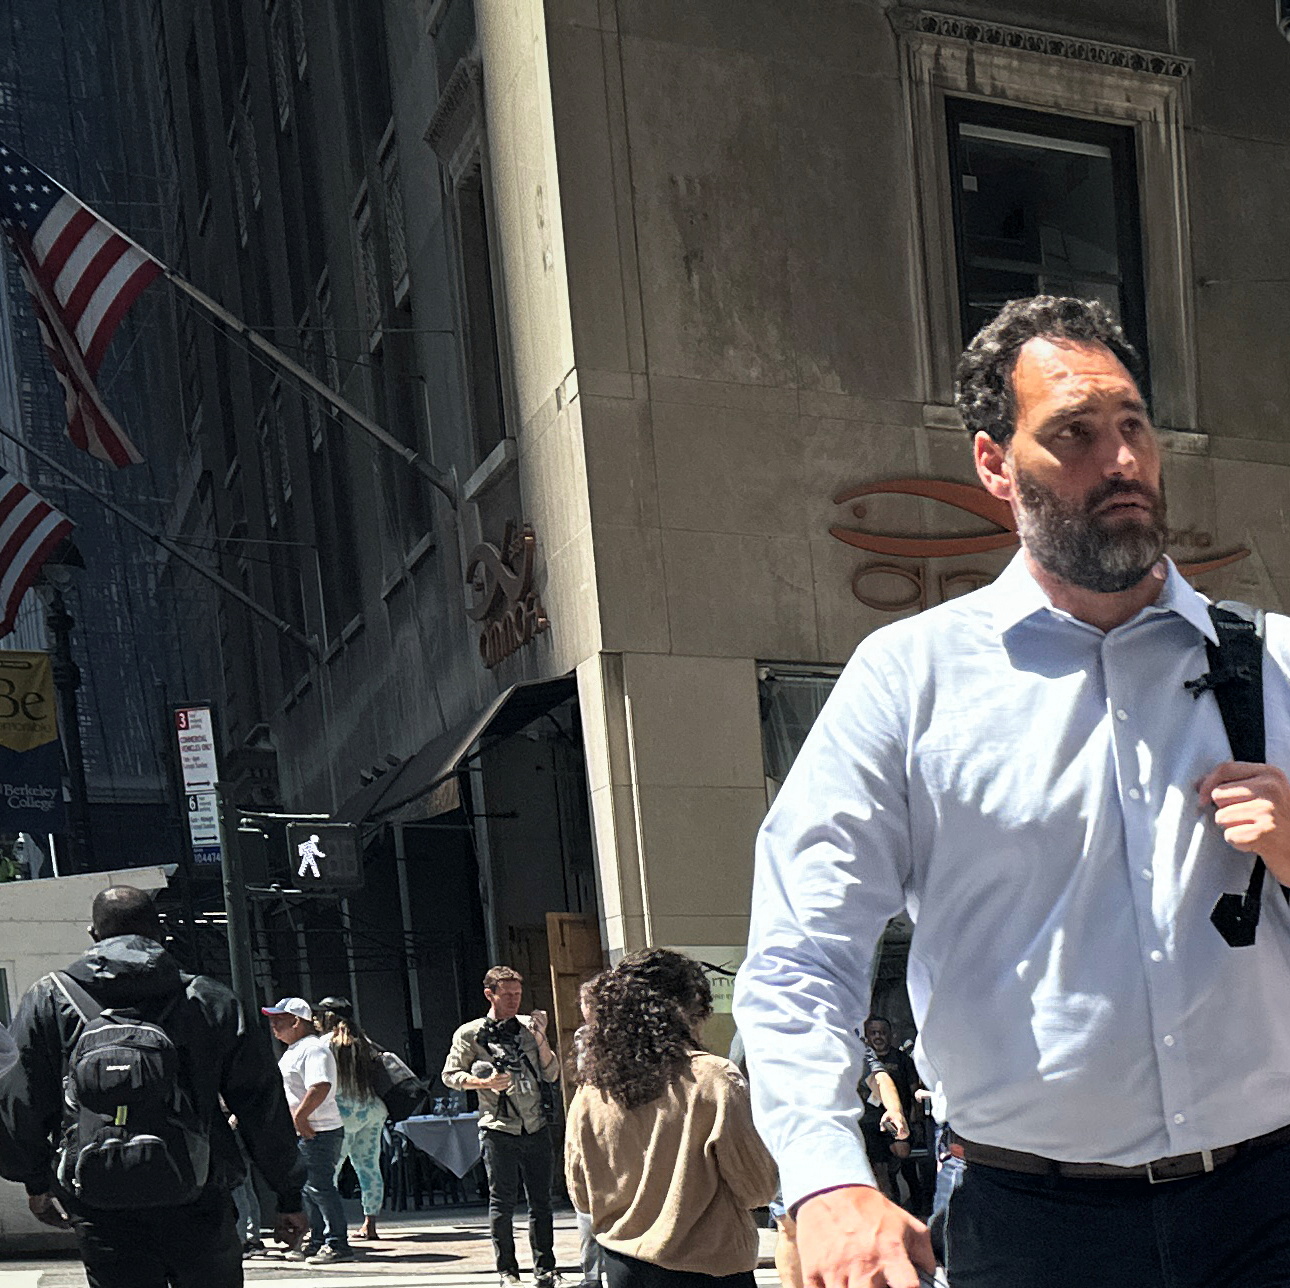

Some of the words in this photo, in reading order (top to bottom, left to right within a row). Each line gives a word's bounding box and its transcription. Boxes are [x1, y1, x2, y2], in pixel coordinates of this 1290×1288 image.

[179, 712, 187, 728] 3
[3, 783, 58, 799] Berkeley
[7, 796, 56, 811] College
[189, 796, 196, 810] 6
